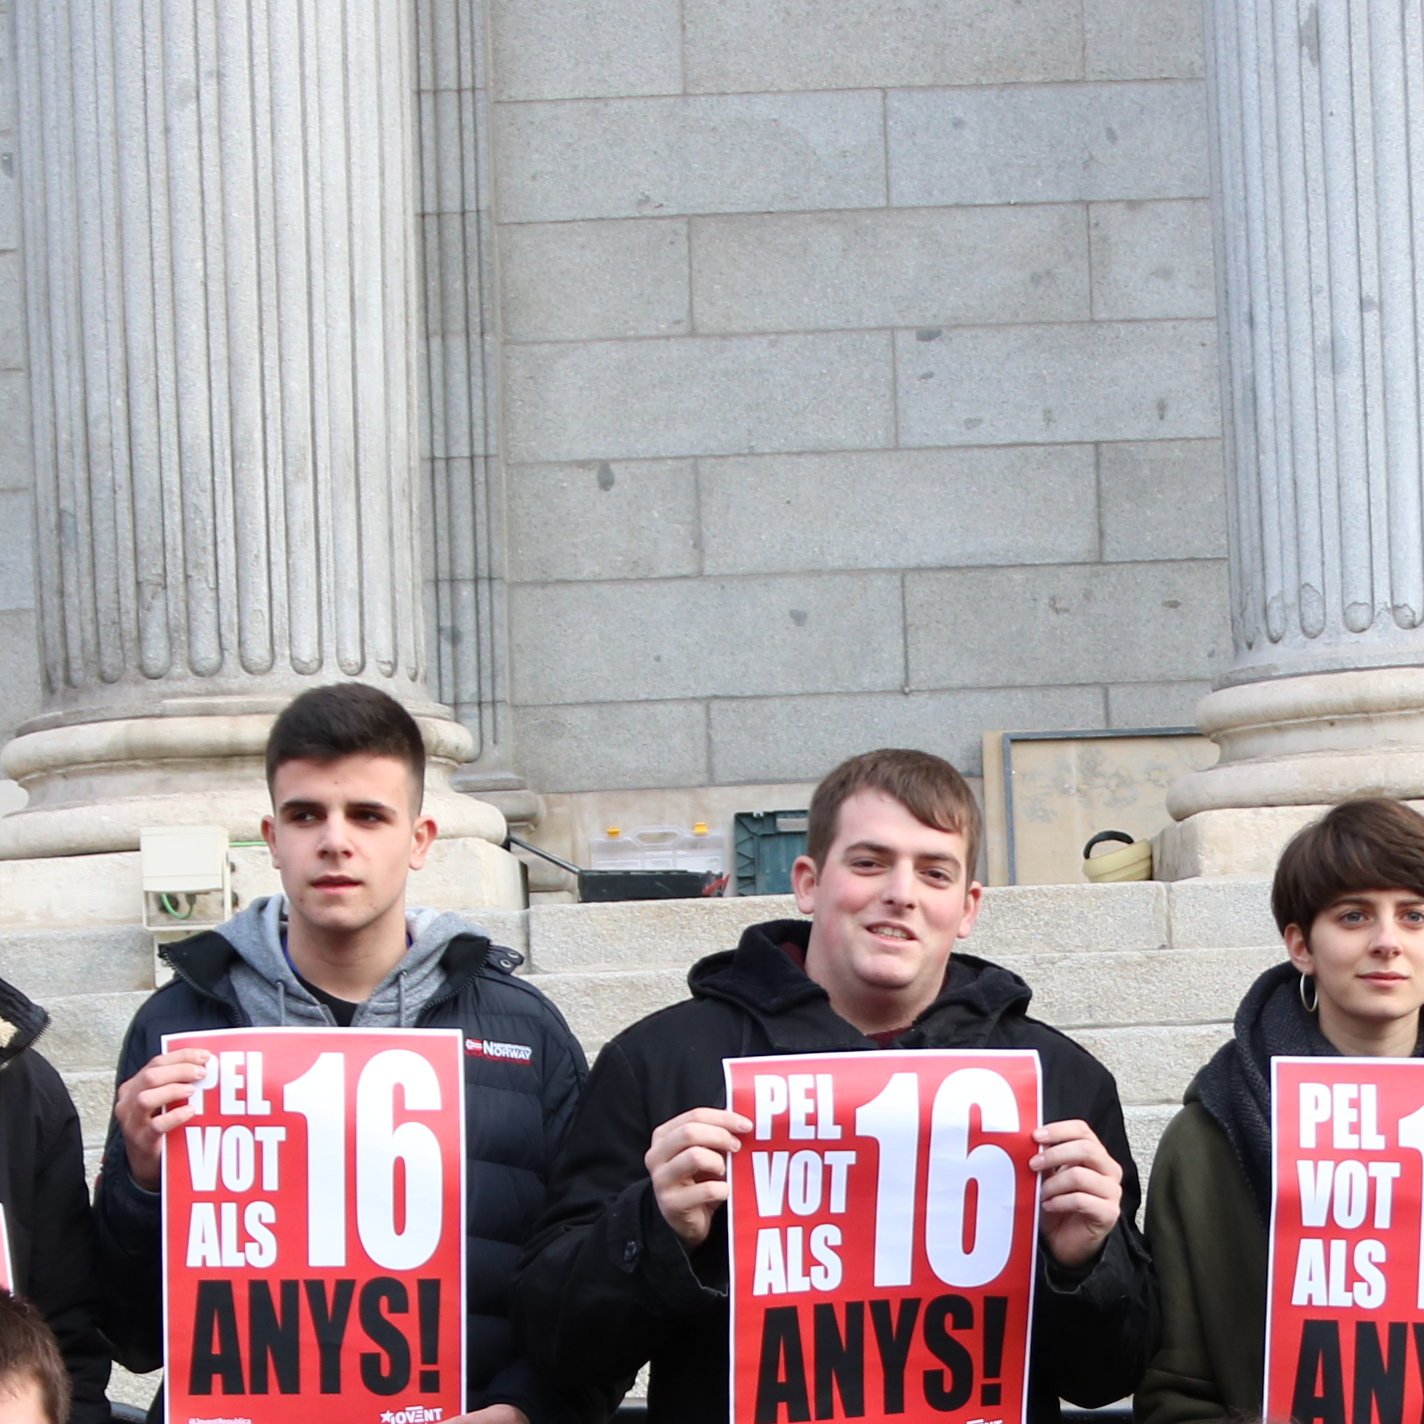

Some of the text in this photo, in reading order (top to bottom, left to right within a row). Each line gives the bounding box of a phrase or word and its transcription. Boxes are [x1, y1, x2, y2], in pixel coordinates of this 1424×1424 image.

[188, 1051, 271, 1116] PEL
[753, 1074, 842, 1140] PEL
[1298, 1082, 1385, 1150] PEL
[185, 1124, 286, 1193] VOT
[283, 1049, 442, 1271] 16
[752, 1149, 856, 1217] VOT
[855, 1067, 1020, 1288] 16
[1296, 1160, 1400, 1229] VOT
[185, 1201, 277, 1268] ALS
[752, 1223, 842, 1296] ALS
[1291, 1238, 1387, 1309] ALS
[188, 1276, 442, 1397] ANYS!
